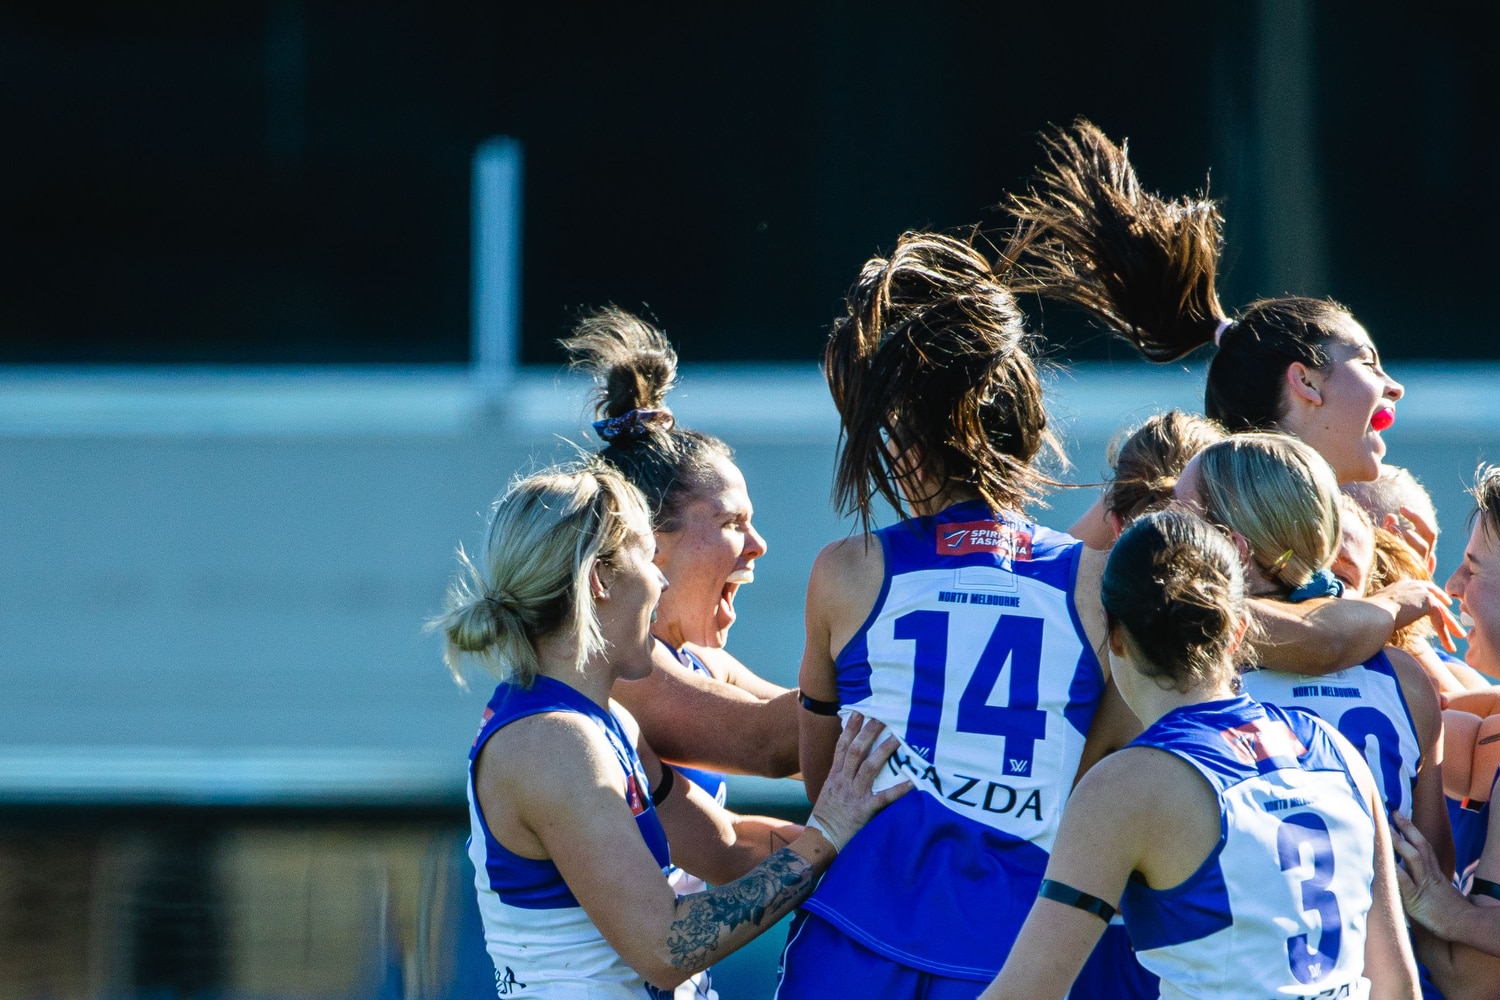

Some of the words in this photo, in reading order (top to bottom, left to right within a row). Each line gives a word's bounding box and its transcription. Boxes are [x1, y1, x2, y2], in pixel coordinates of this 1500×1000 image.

[938, 591, 969, 604] NORTH
[970, 593, 1020, 607] MELBOURNE
[893, 609, 1047, 777] 14
[1292, 685, 1319, 698] NORTH
[1321, 685, 1362, 699] MELBOURNE
[1277, 812, 1343, 986] 3
